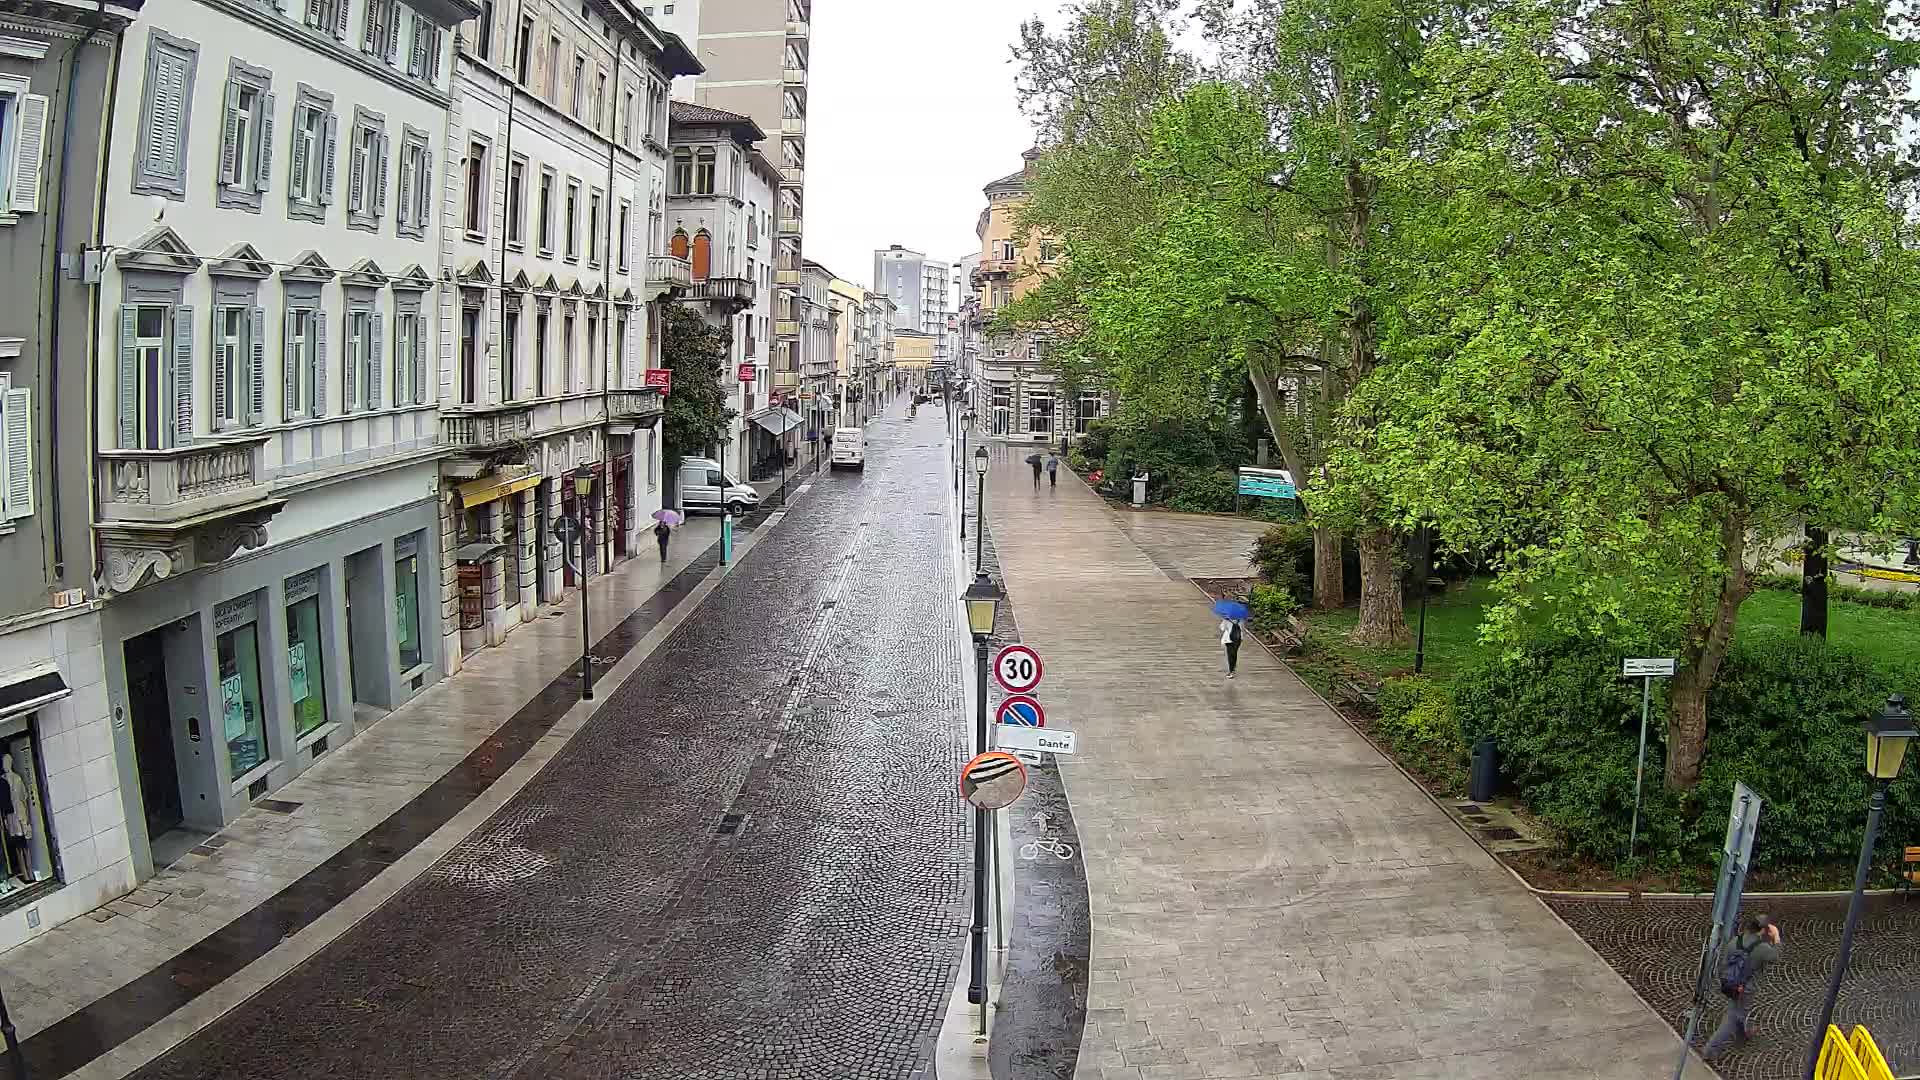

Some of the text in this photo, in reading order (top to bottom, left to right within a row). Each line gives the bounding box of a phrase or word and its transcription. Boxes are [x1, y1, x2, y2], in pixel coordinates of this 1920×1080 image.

[1005, 658, 1033, 681] 30
[223, 677, 241, 700] 130
[1038, 738, 1069, 749] Dante
